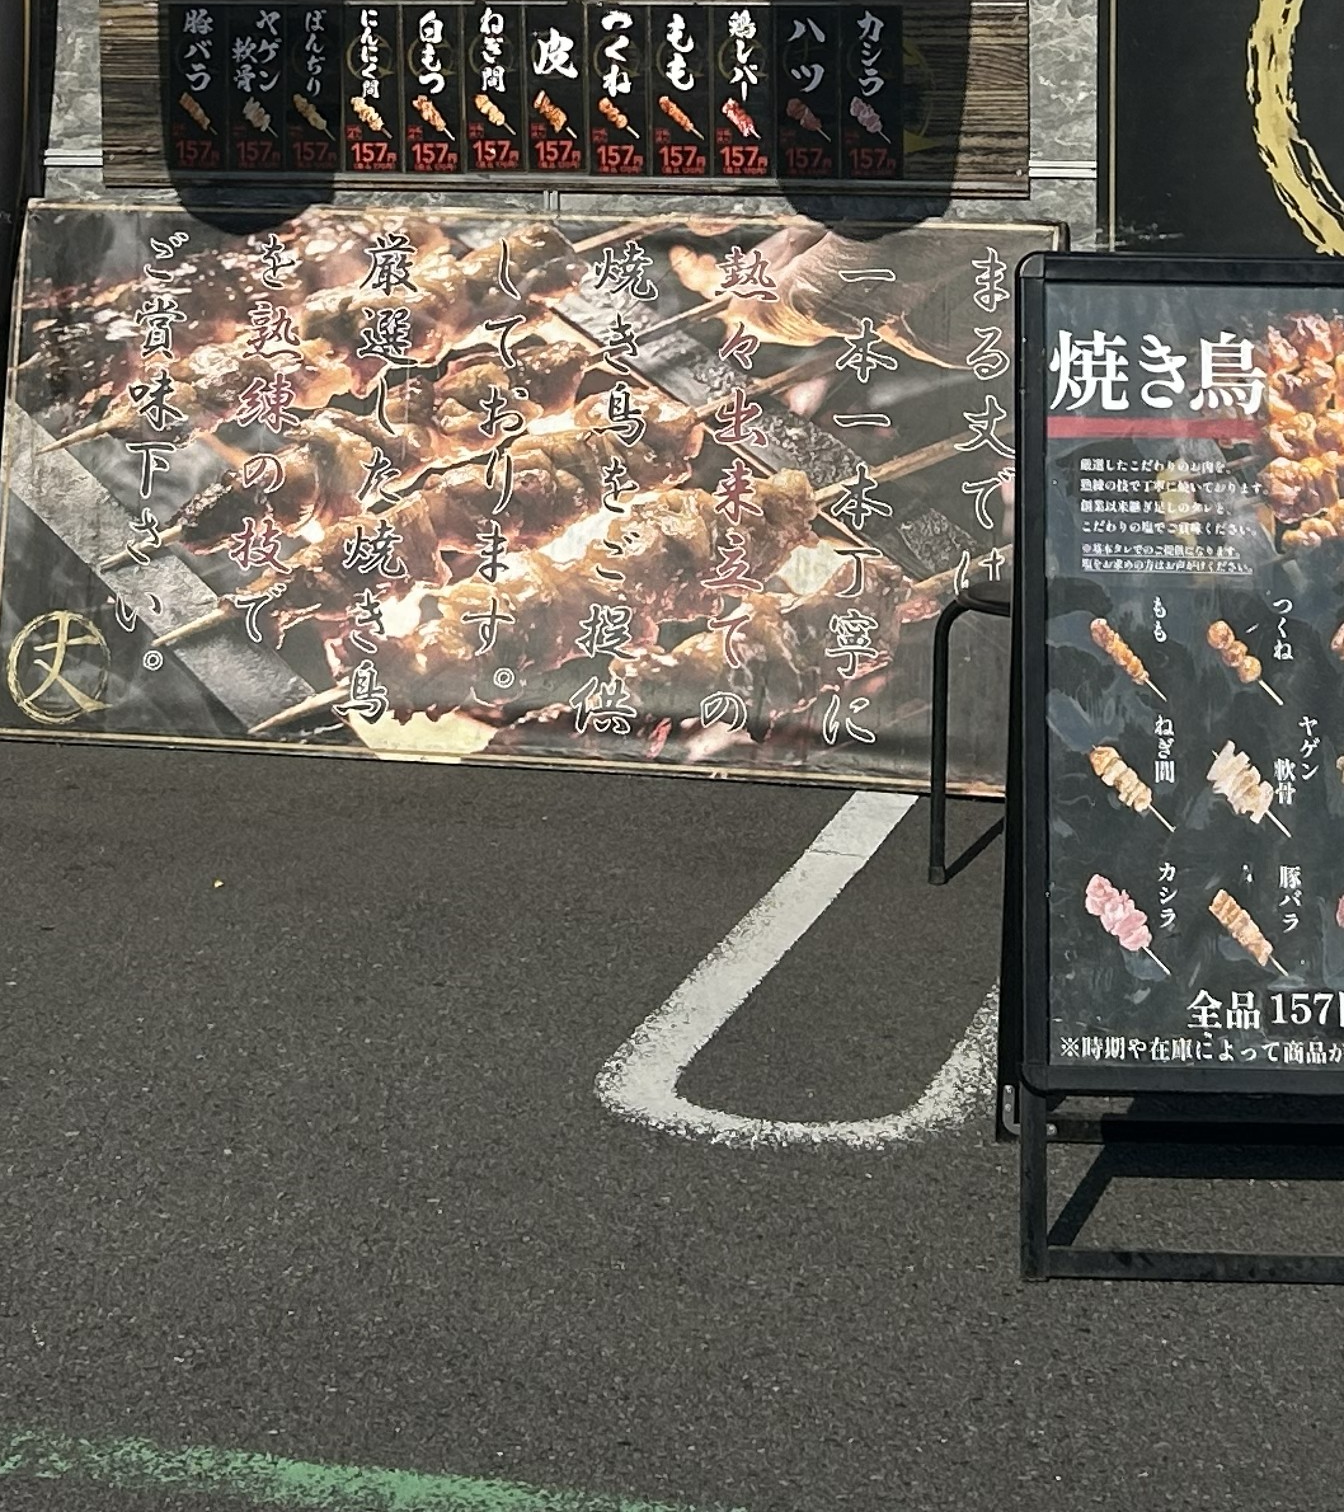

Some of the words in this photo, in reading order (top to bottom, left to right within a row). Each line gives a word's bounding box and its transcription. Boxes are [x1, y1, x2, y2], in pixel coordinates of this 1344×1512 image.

[183, 9, 214, 90] 豚バラ
[232, 36, 257, 93] 軟骨
[256, 9, 282, 92] ヤゲン
[361, 9, 381, 99] にんにく間
[419, 10, 446, 94] 白もつ
[479, 8, 506, 92] ねぎ間
[533, 28, 579, 79] 皮
[600, 10, 633, 97] つくね
[666, 13, 696, 91] もも
[728, 10, 758, 101] 鶏レバー
[787, 18, 826, 93] ハツ
[857, 10, 886, 97] カシラ
[1048, 328, 1267, 415] 焼き鳥
[112, 229, 190, 674] ご賞味下さい。
[229, 234, 304, 647] を熟練の技で
[331, 234, 424, 724] 厳選した焼き鳥
[459, 235, 529, 692] しております。
[571, 245, 659, 737] 焼き鳥をご提供
[699, 245, 780, 734] 熱々出来立ての
[819, 262, 902, 747] 一本一本丁寧に
[1152, 595, 1168, 643] もも
[1272, 597, 1295, 662] つくね
[1154, 715, 1175, 785] ねぎ間
[1273, 758, 1296, 805] 軟骨
[1297, 714, 1320, 783] ヤゲン
[1158, 863, 1178, 928] カシラ
[1278, 865, 1302, 932] 豚バラ
[1187, 989, 1261, 1032] 全品
